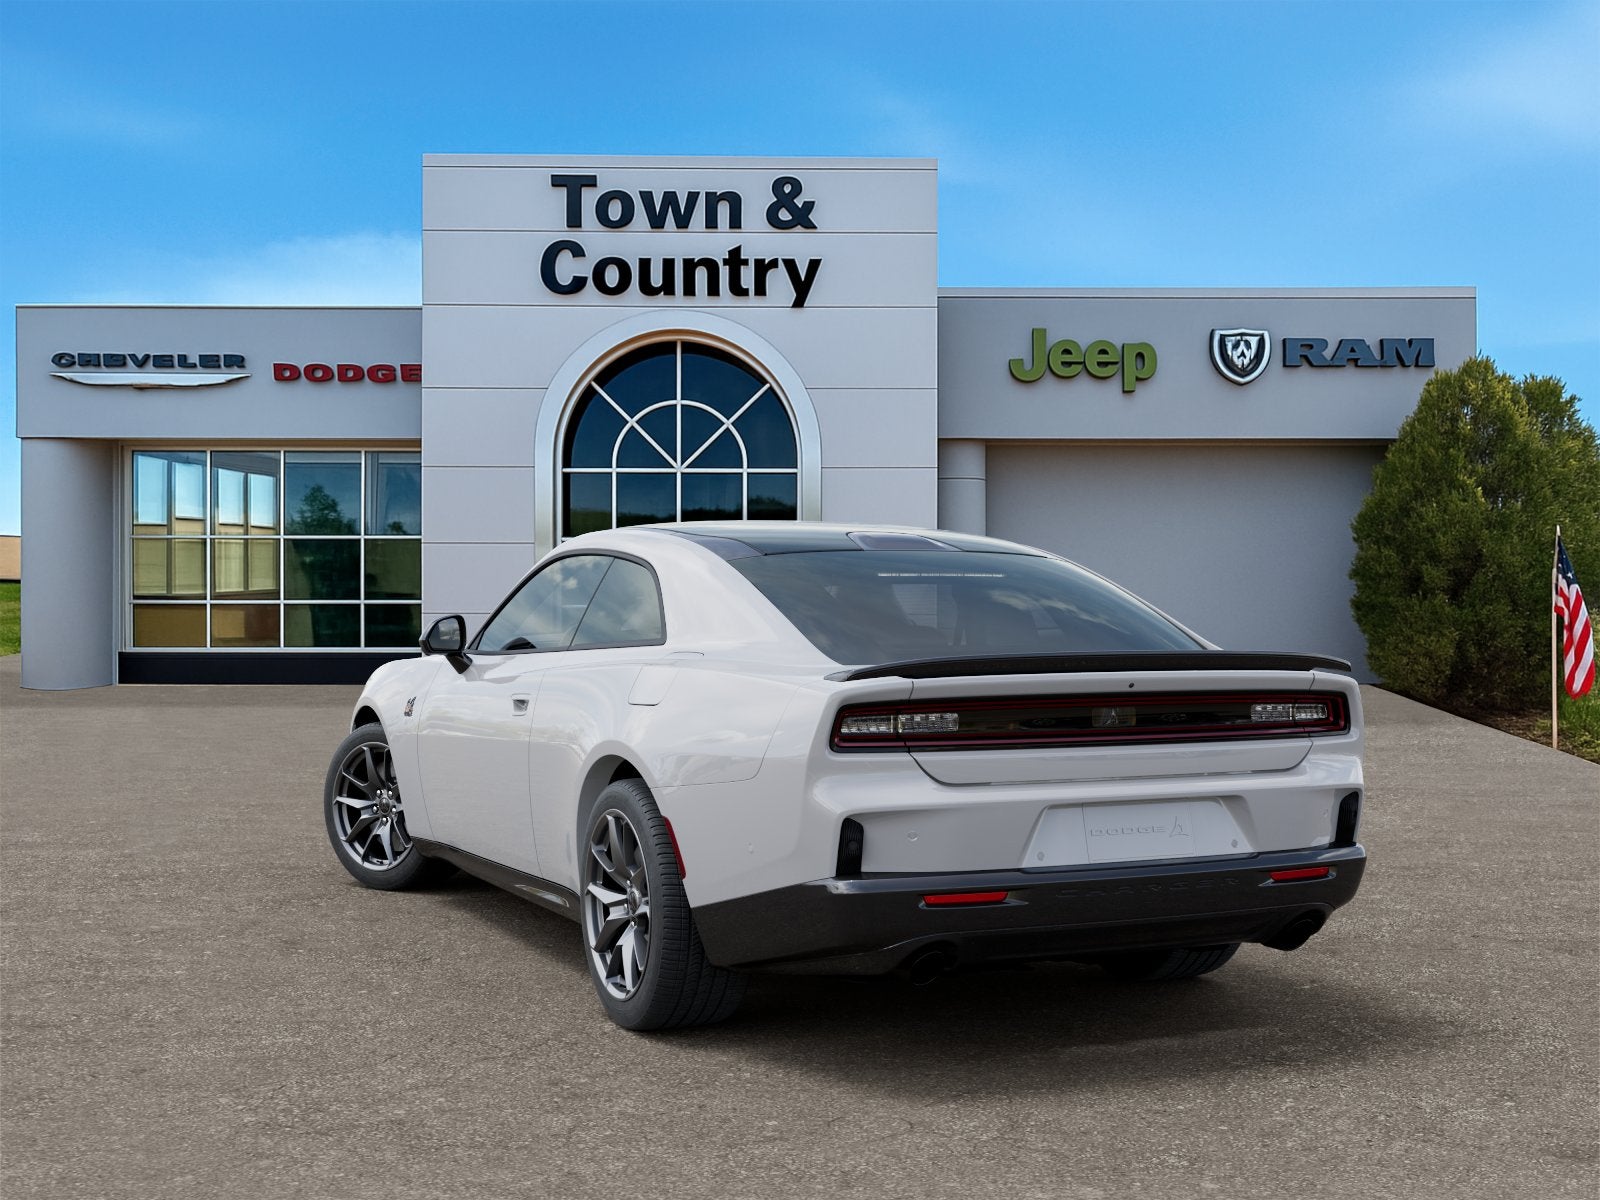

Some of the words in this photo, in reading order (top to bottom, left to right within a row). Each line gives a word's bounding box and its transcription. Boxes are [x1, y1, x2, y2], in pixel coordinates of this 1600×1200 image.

[551, 174, 742, 229] Town
[765, 175, 818, 230] &
[540, 239, 822, 308] Country
[273, 363, 422, 383] DODGE
[1009, 327, 1158, 393] Jeep
[1283, 337, 1436, 368] RAM
